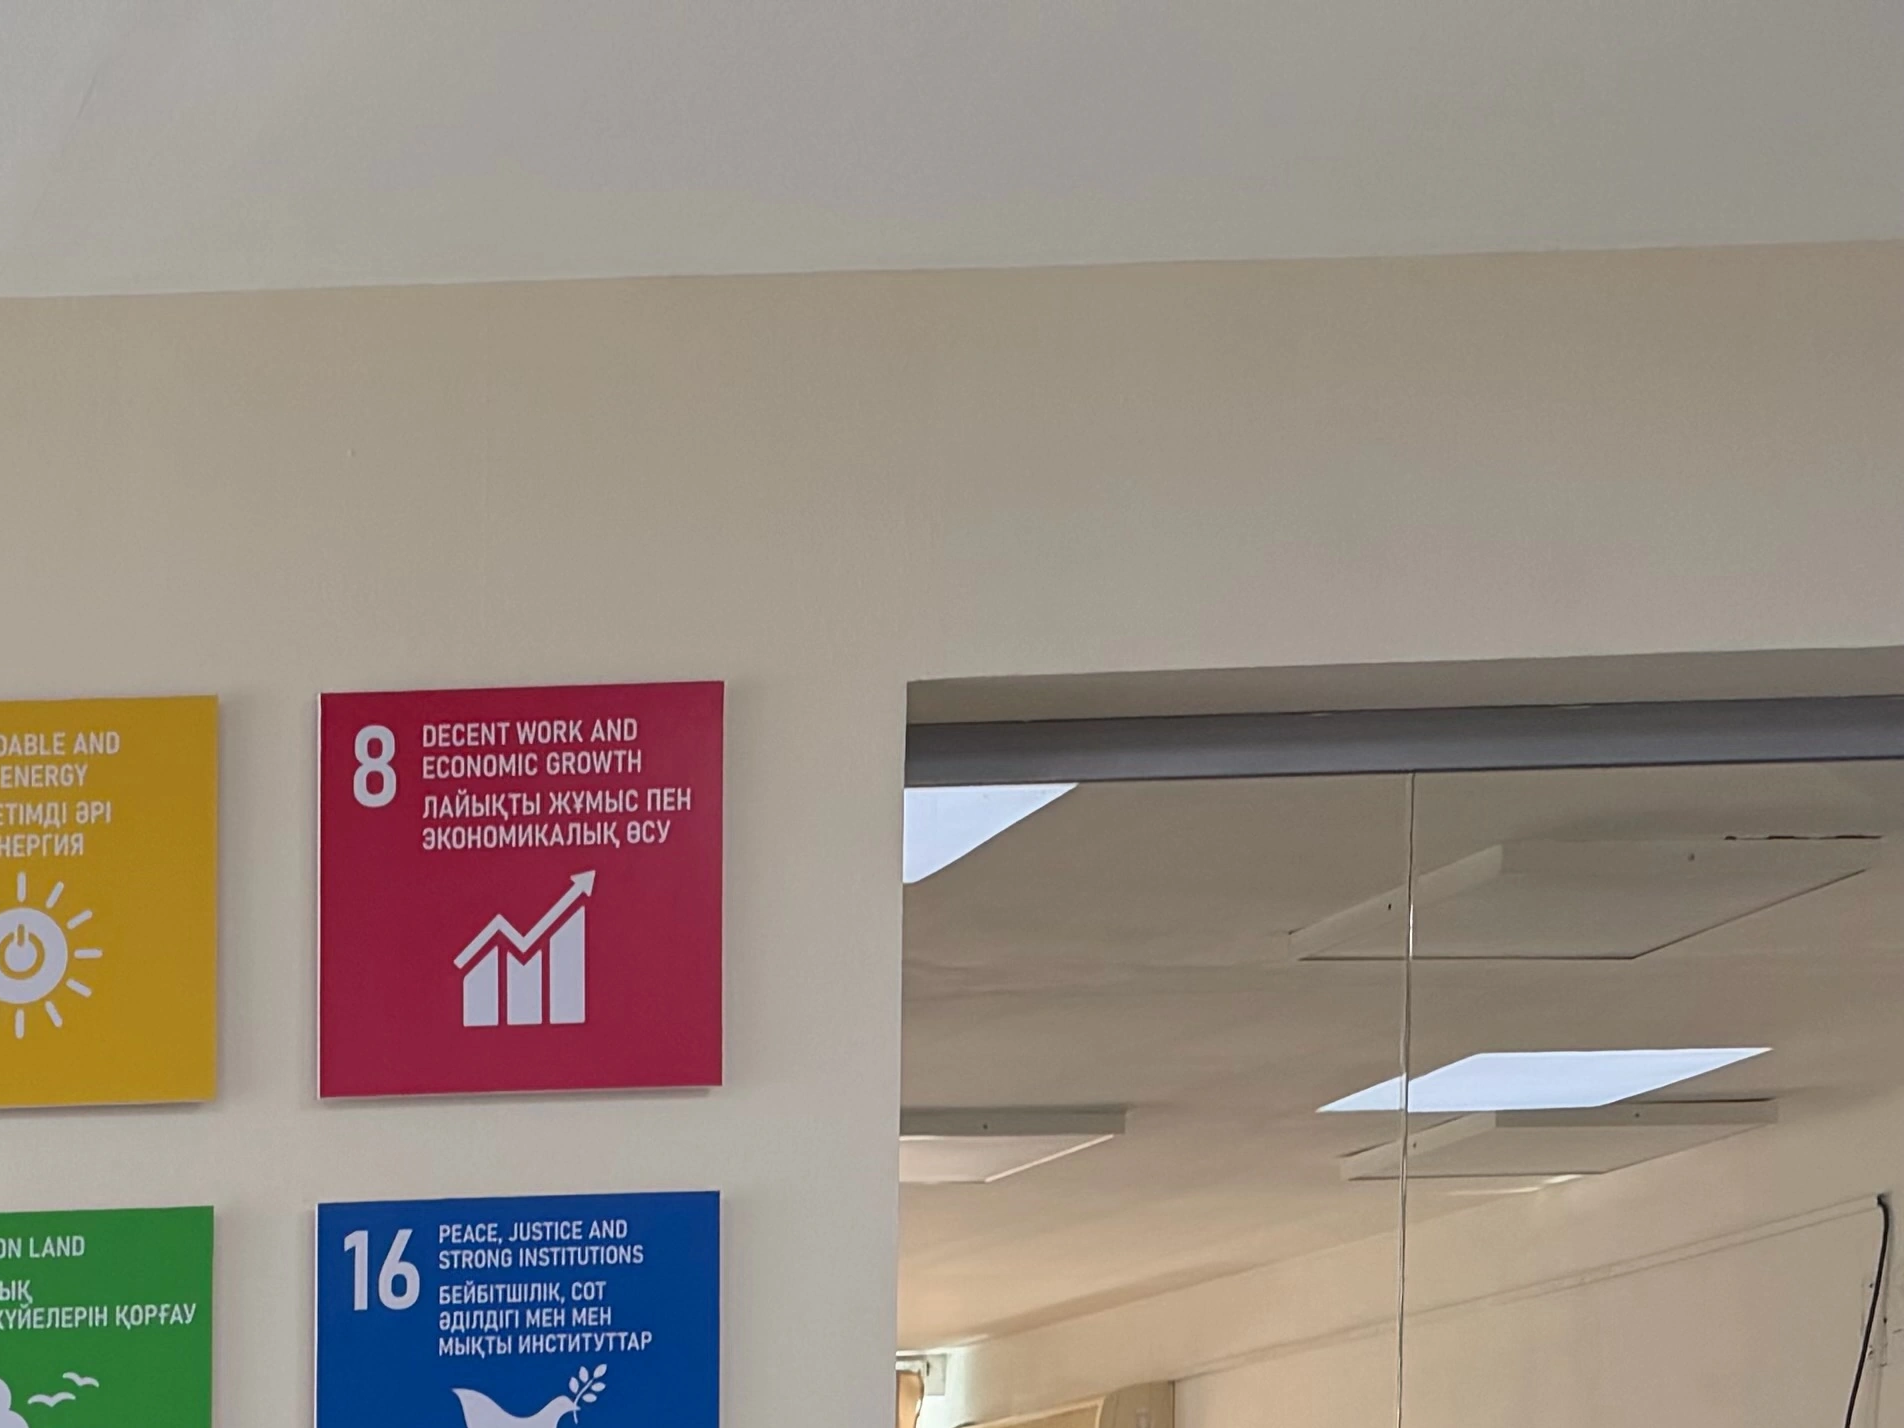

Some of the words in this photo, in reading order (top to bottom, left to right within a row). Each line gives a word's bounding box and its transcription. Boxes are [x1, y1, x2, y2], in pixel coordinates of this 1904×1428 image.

[74, 732, 119, 754] AND
[423, 723, 509, 747] DECENT
[517, 720, 583, 744] WORK
[591, 718, 637, 742] AND
[1, 764, 87, 788] ENERGY
[354, 725, 396, 807] 8
[423, 753, 537, 778] ECONOMIC
[547, 750, 641, 774] GROWTH
[76, 801, 111, 824] ӘРІ
[439, 1224, 502, 1244] PEACE,
[509, 1221, 582, 1241] JUSTICE
[589, 1220, 627, 1239] AND
[30, 1236, 84, 1257] LAND
[439, 1249, 512, 1269] STRONG
[520, 1245, 643, 1267] INSTITUTIONS
[344, 1229, 419, 1310] 16
